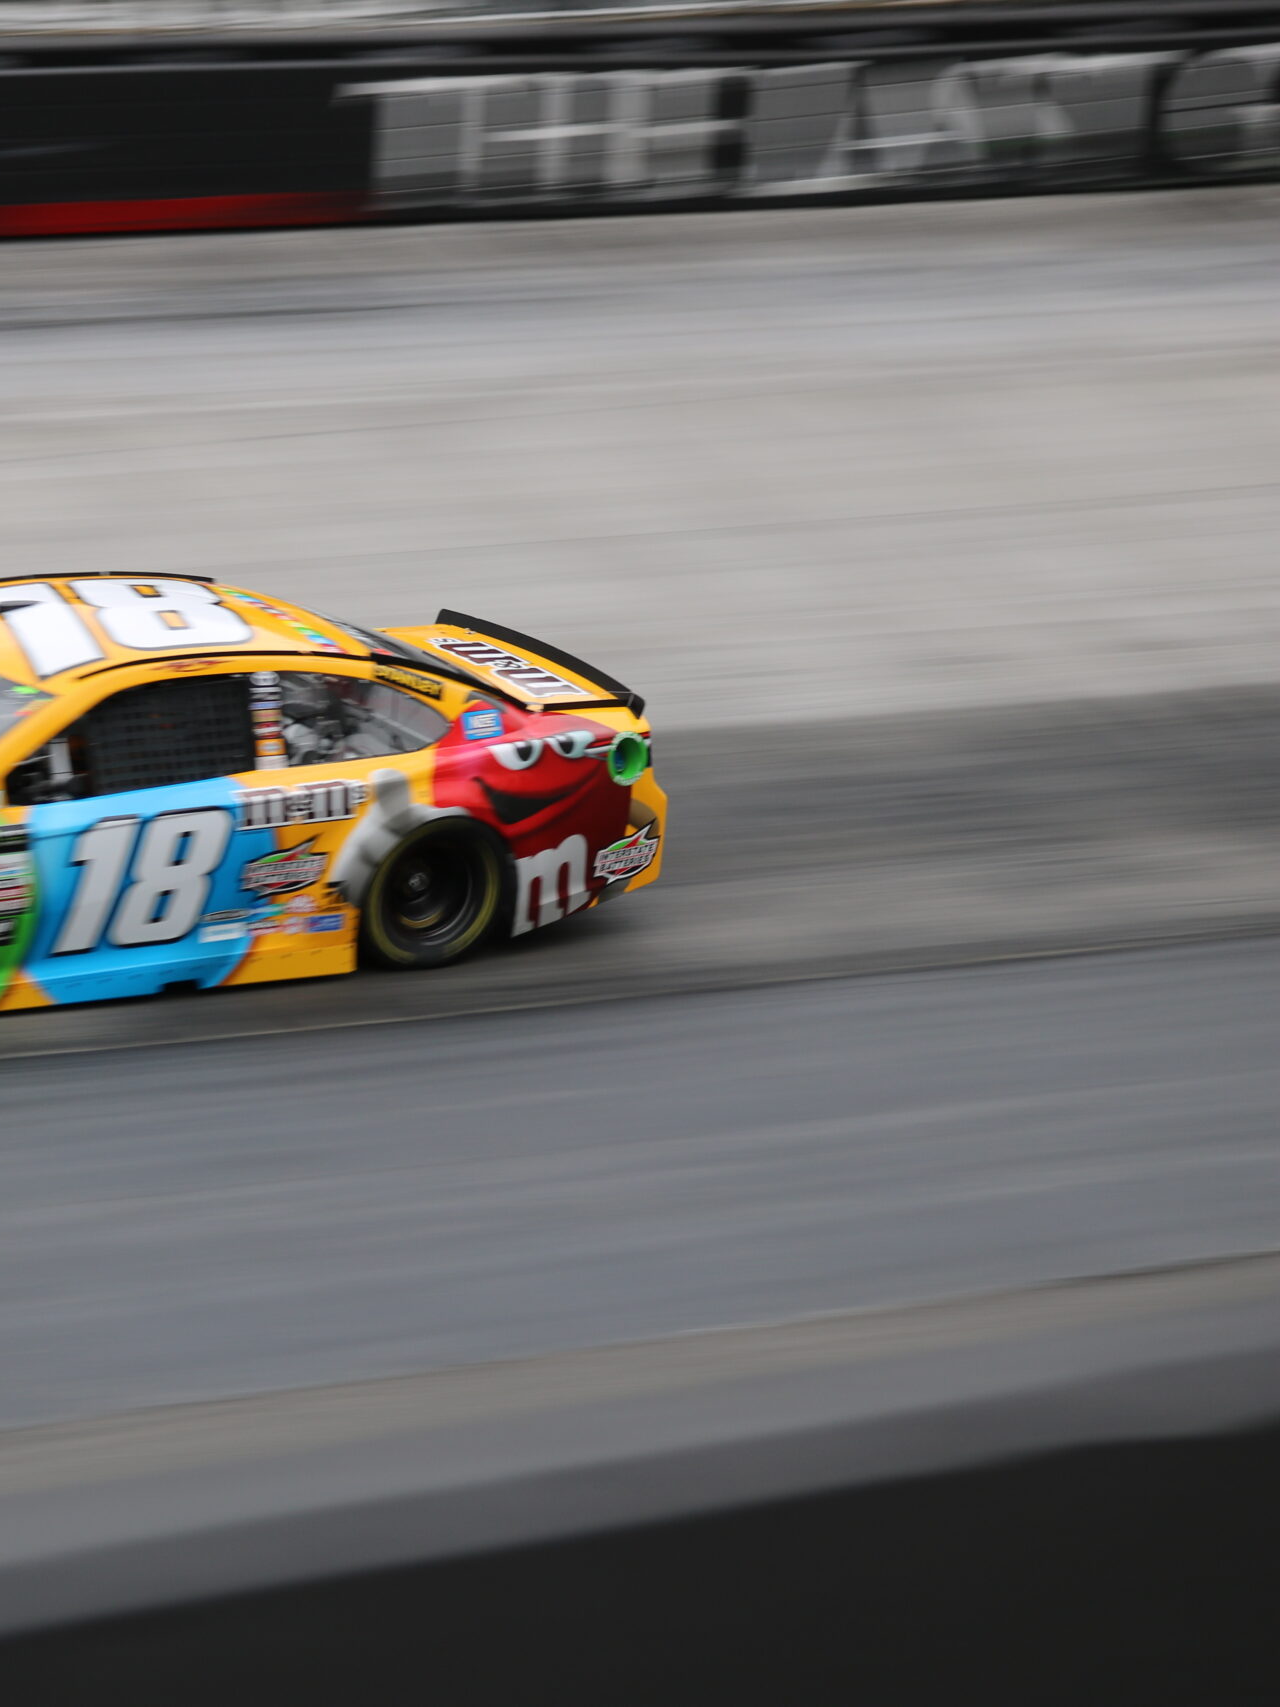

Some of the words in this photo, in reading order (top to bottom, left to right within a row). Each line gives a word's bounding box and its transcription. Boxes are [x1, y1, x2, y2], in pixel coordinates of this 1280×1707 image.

[332, 66, 738, 208] THE
[45, 807, 232, 957] 18
[511, 833, 591, 938] m
